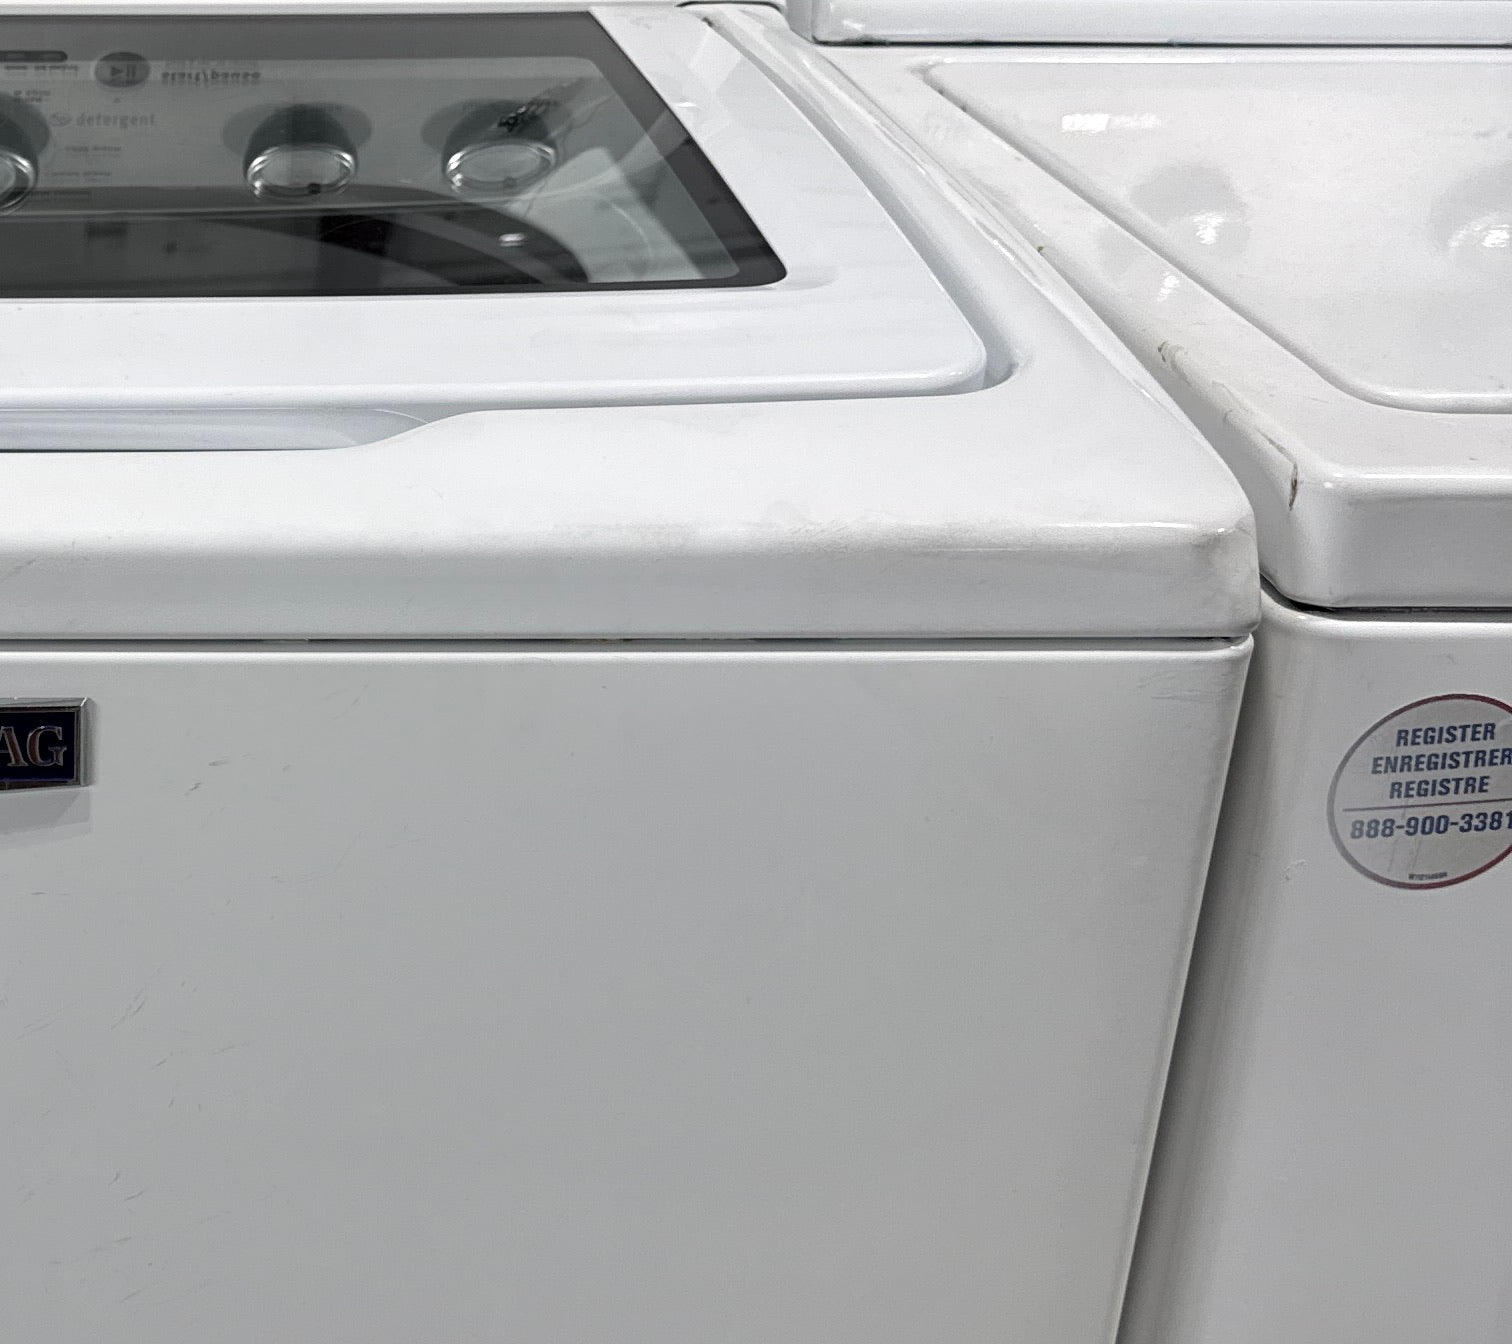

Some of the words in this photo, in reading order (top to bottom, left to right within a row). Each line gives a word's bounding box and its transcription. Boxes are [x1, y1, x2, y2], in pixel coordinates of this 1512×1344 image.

[77, 112, 155, 129] detergent
[1396, 722, 1497, 747] REGISTER
[1371, 747, 1512, 775] ENREGISTRER
[1389, 775, 1491, 800] REGISTRE
[1350, 811, 1512, 839] 888-900-3381
